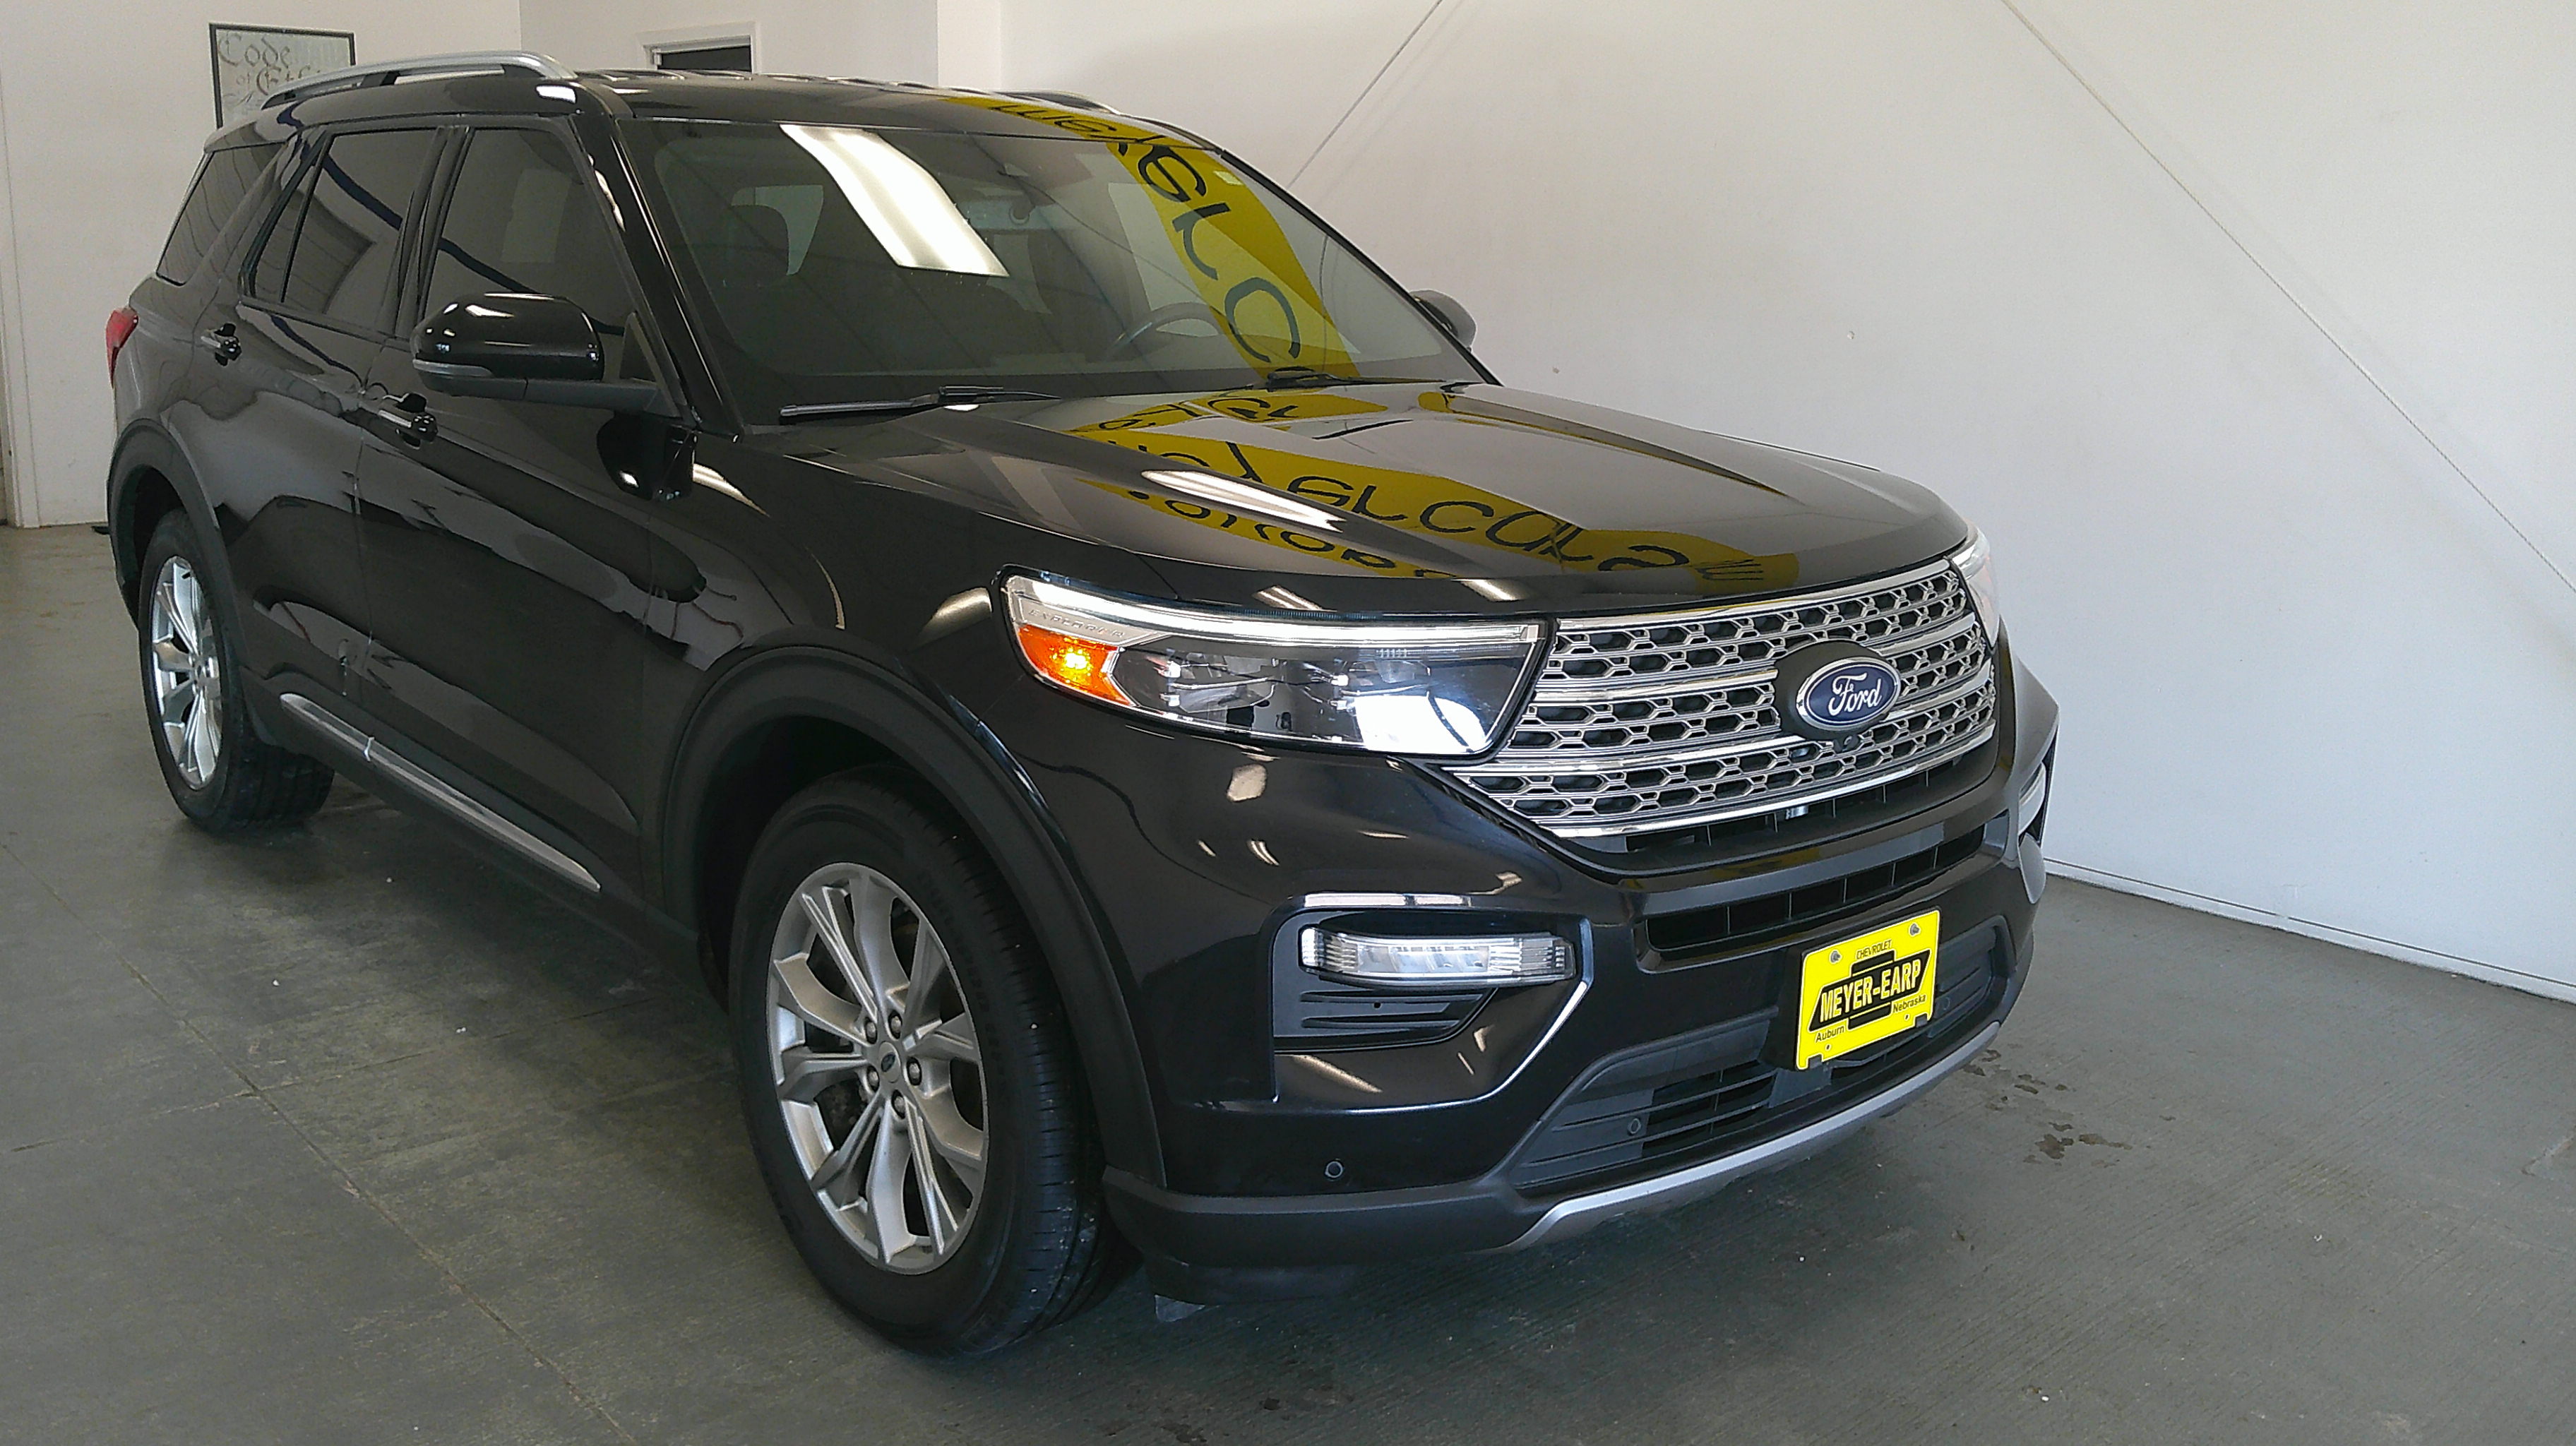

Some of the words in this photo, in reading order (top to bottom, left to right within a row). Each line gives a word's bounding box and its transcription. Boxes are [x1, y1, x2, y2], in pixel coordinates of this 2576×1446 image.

[218, 32, 292, 68] Code
[1828, 672, 1883, 716] Ford
[1856, 939, 1892, 960] CHEVROLET
[1820, 959, 1921, 1022] MEYER-EARP
[1815, 1026, 1844, 1043] Auburn
[1893, 993, 1927, 1013] Nebraska
